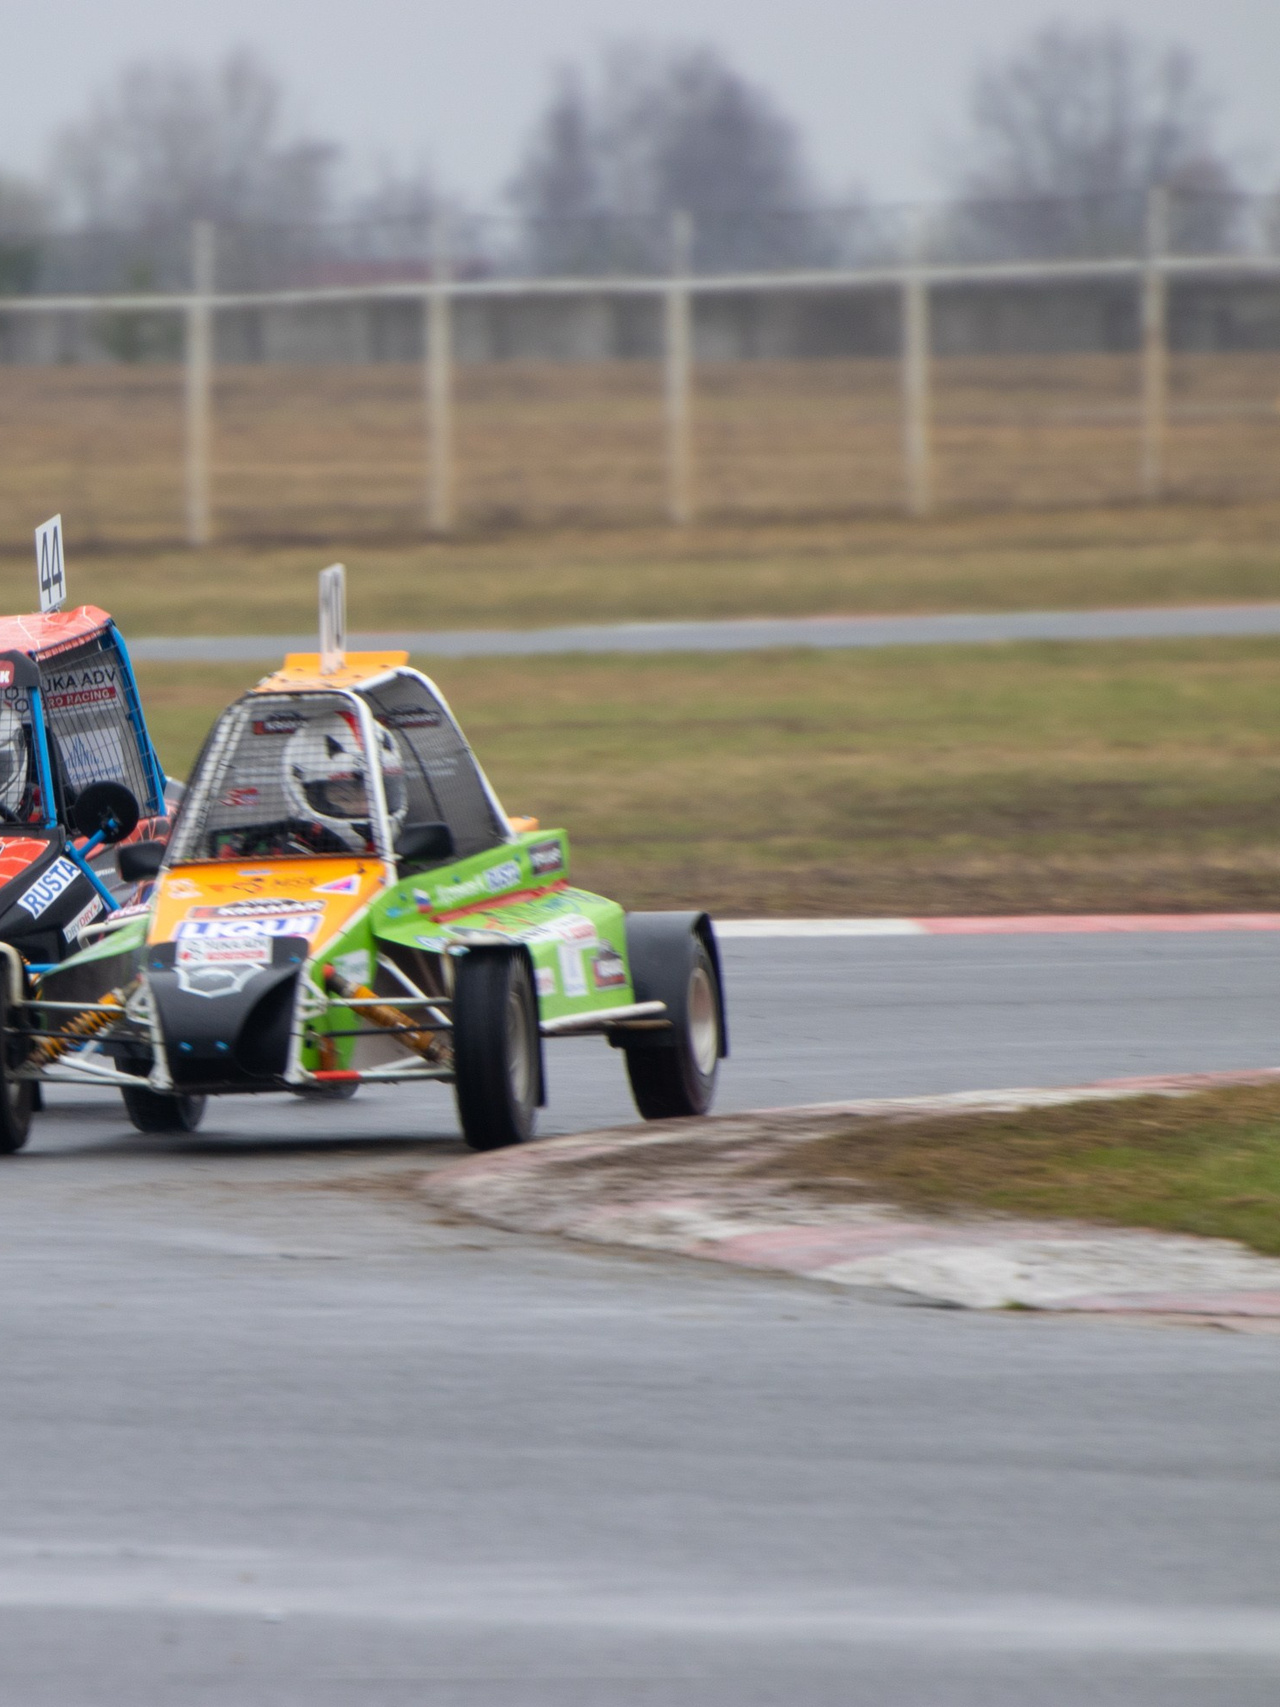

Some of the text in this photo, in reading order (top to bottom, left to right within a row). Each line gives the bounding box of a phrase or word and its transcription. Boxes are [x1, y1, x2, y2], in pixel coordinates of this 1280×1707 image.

[41, 525, 63, 604] 44
[81, 667, 116, 687] ADV
[66, 689, 110, 705] RACING
[23, 859, 80, 917] RUSTA
[179, 916, 315, 939] LIQUI
